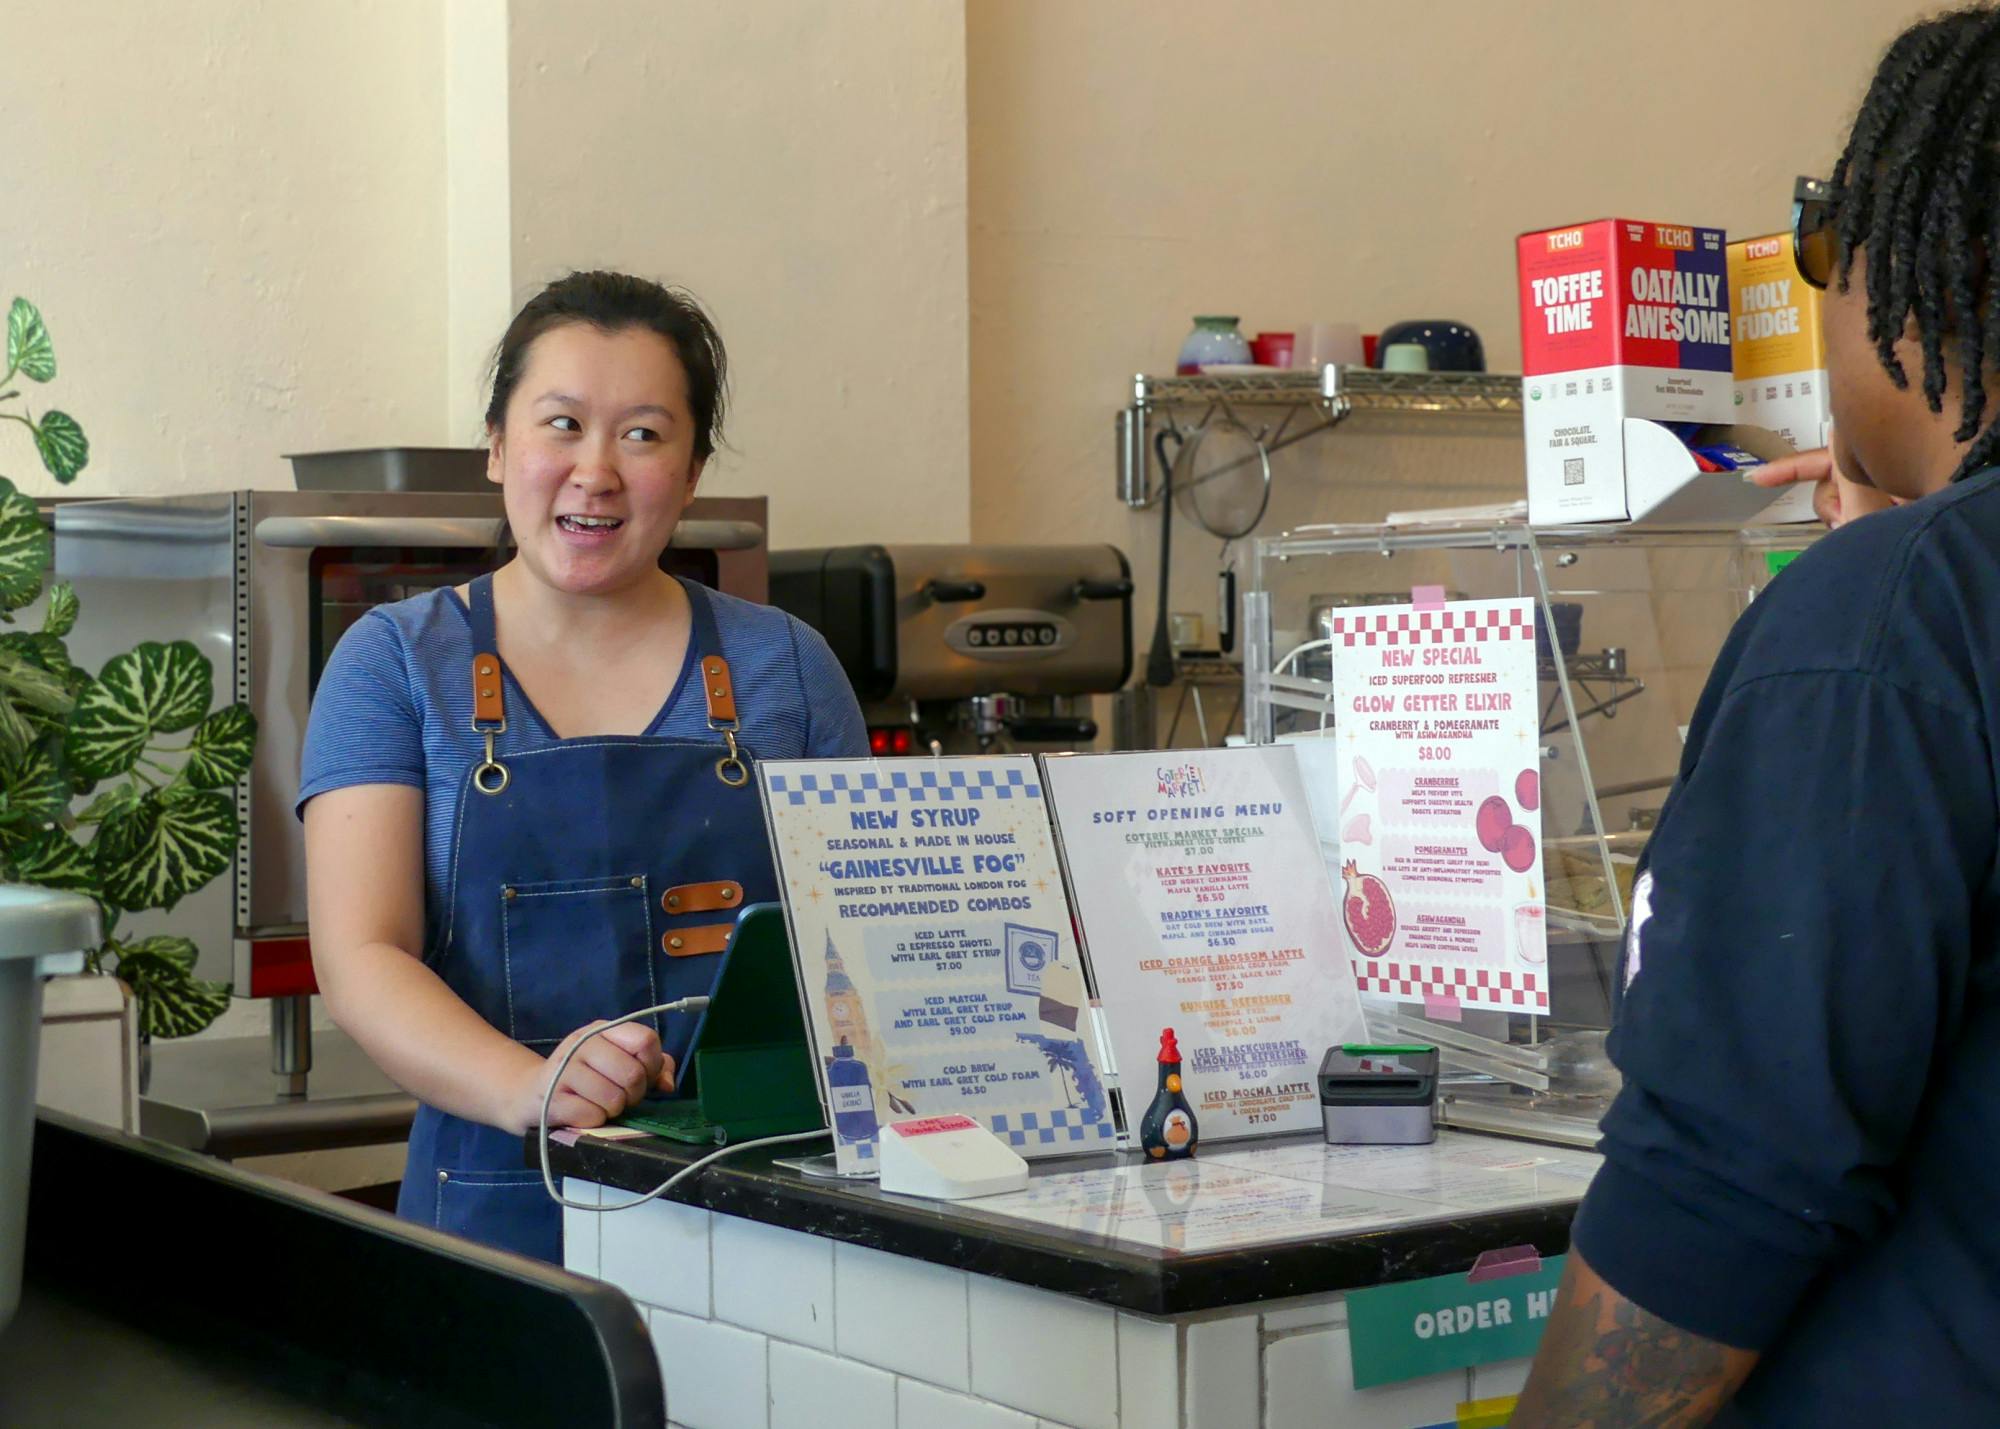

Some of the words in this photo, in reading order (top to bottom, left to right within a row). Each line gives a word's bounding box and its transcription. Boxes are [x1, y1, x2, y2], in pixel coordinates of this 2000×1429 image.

[1549, 231, 1581, 249] TCHO
[1658, 228, 1691, 246] TCHO
[1747, 240, 1778, 258] TCHO
[1532, 270, 1603, 306] TOFFEE
[1631, 267, 1720, 307] OATALLY
[1741, 279, 1792, 313] HOLY
[1545, 302, 1592, 333] TIME
[1625, 304, 1730, 345] AWESOME
[1737, 307, 1799, 342] FUDGE
[1678, 387, 1703, 395] Chocolate
[1554, 426, 1592, 437] CHOCOLATE.
[1550, 438, 1563, 448] FAIR
[1564, 438, 1569, 446] &
[1571, 435, 1598, 445] SQUARE.
[1382, 649, 1414, 667] NEW
[1423, 647, 1482, 666] SPECIAL
[1369, 675, 1388, 686] ICED
[1392, 674, 1444, 685] SUPERFOOD
[1449, 673, 1496, 683] REFRESHER
[1353, 696, 1395, 712] GLOW
[1403, 694, 1457, 711] GETTER
[1466, 693, 1512, 711] ELIXIR
[1370, 721, 1419, 731] CRANBERRY
[1424, 721, 1429, 730] &
[1434, 720, 1499, 730] POMEGRANATE
[1396, 731, 1413, 739] WITH
[1417, 731, 1473, 739] ASHWAGANDHA
[1419, 747, 1451, 760] $8.00
[1157, 764, 1196, 784] COTERIE
[850, 811, 897, 829] NEW
[912, 808, 980, 828] SYRUP
[1093, 810, 1136, 823] SOFT
[1147, 806, 1225, 820] OPENING
[1235, 803, 1282, 816] MENU
[827, 838, 893, 850] SEASONAL
[900, 838, 908, 847] &
[915, 836, 951, 847] MADE
[958, 835, 969, 845] IN
[975, 834, 1016, 845] HOUSE
[1126, 832, 1168, 842] COTERIE
[1175, 829, 1218, 840] MARKET
[1222, 827, 1264, 837] SPECIAL
[1144, 839, 1193, 849] VIETNAMESE
[1219, 836, 1246, 844] COFFEE
[1184, 847, 1214, 856] $7.00
[820, 856, 963, 879] “GAINESVILLE
[974, 854, 1025, 873] FOG”
[1156, 866, 1193, 878] KATE'S
[1198, 863, 1251, 873] FAVORITE
[1209, 875, 1248, 883] CINNAMON
[834, 885, 876, 896] INSPIRED
[881, 885, 893, 894] BY
[899, 882, 961, 893] TRADITIONAL
[964, 880, 1004, 890] LONDON
[1008, 880, 1027, 888] FOG
[1194, 885, 1224, 893] VANILLA
[1197, 893, 1225, 902] $6.50
[839, 900, 959, 918] RECOMMENDED
[968, 897, 1032, 912] COMBOS
[1161, 909, 1211, 921] BRADEN'S
[1216, 905, 1269, 916] FAVORITE
[1417, 915, 1465, 924] ASHWAGANDHA
[939, 930, 966, 938] LATTE
[897, 943, 906, 951] (2
[910, 941, 955, 950] ESPRESSO
[959, 939, 992, 948] SHOTS)
[1208, 937, 1236, 947] $6.50
[891, 954, 915, 962] WITH
[919, 952, 942, 960] EARL
[946, 951, 968, 959] GREY
[973, 949, 1001, 958] SYRUP
[1139, 959, 1163, 969] ICED
[1168, 956, 1212, 967] ORANGE
[1218, 952, 1268, 964] BLOSSOM
[1272, 948, 1305, 960] LATTE
[936, 962, 962, 970] $7.00
[1216, 981, 1244, 992] $7.50
[924, 997, 944, 1005] ICED
[949, 994, 988, 1003] MATCHA
[1232, 994, 1292, 1008] REFRESHER
[903, 1008, 927, 1017] WITH
[930, 1007, 953, 1015] EARL
[957, 1005, 978, 1013] GREY
[984, 1002, 1013, 1012] SYRUP
[895, 1020, 913, 1029] AND
[918, 1018, 939, 1027] EARL
[944, 1017, 966, 1025] GREY
[972, 1015, 995, 1023] COLD
[999, 1012, 1026, 1022] FOAM
[950, 1026, 976, 1035] $9.00
[1225, 1026, 1256, 1037] $6.00
[1194, 1048, 1216, 1058] ICED
[1221, 1040, 1300, 1055] BLACKCURRANT
[1191, 1054, 1246, 1066] LEMONADE
[1252, 1048, 1307, 1061] REFRESHER
[943, 1065, 967, 1075] COLD
[971, 1063, 996, 1072] BREW
[1239, 1070, 1268, 1080] $6.00
[902, 1080, 926, 1088] WITH
[930, 1078, 953, 1086] EARL
[957, 1075, 979, 1084] GREY
[985, 1073, 1008, 1082] COLD
[1012, 1071, 1040, 1080] FOAM
[961, 1086, 986, 1095] $6.50
[1204, 1092, 1227, 1101] ICED
[1233, 1086, 1272, 1098] MOCHA
[1278, 1082, 1311, 1093] LATTE
[1249, 1114, 1277, 1124] $7.00
[1414, 1299, 1511, 1339] ORDER
